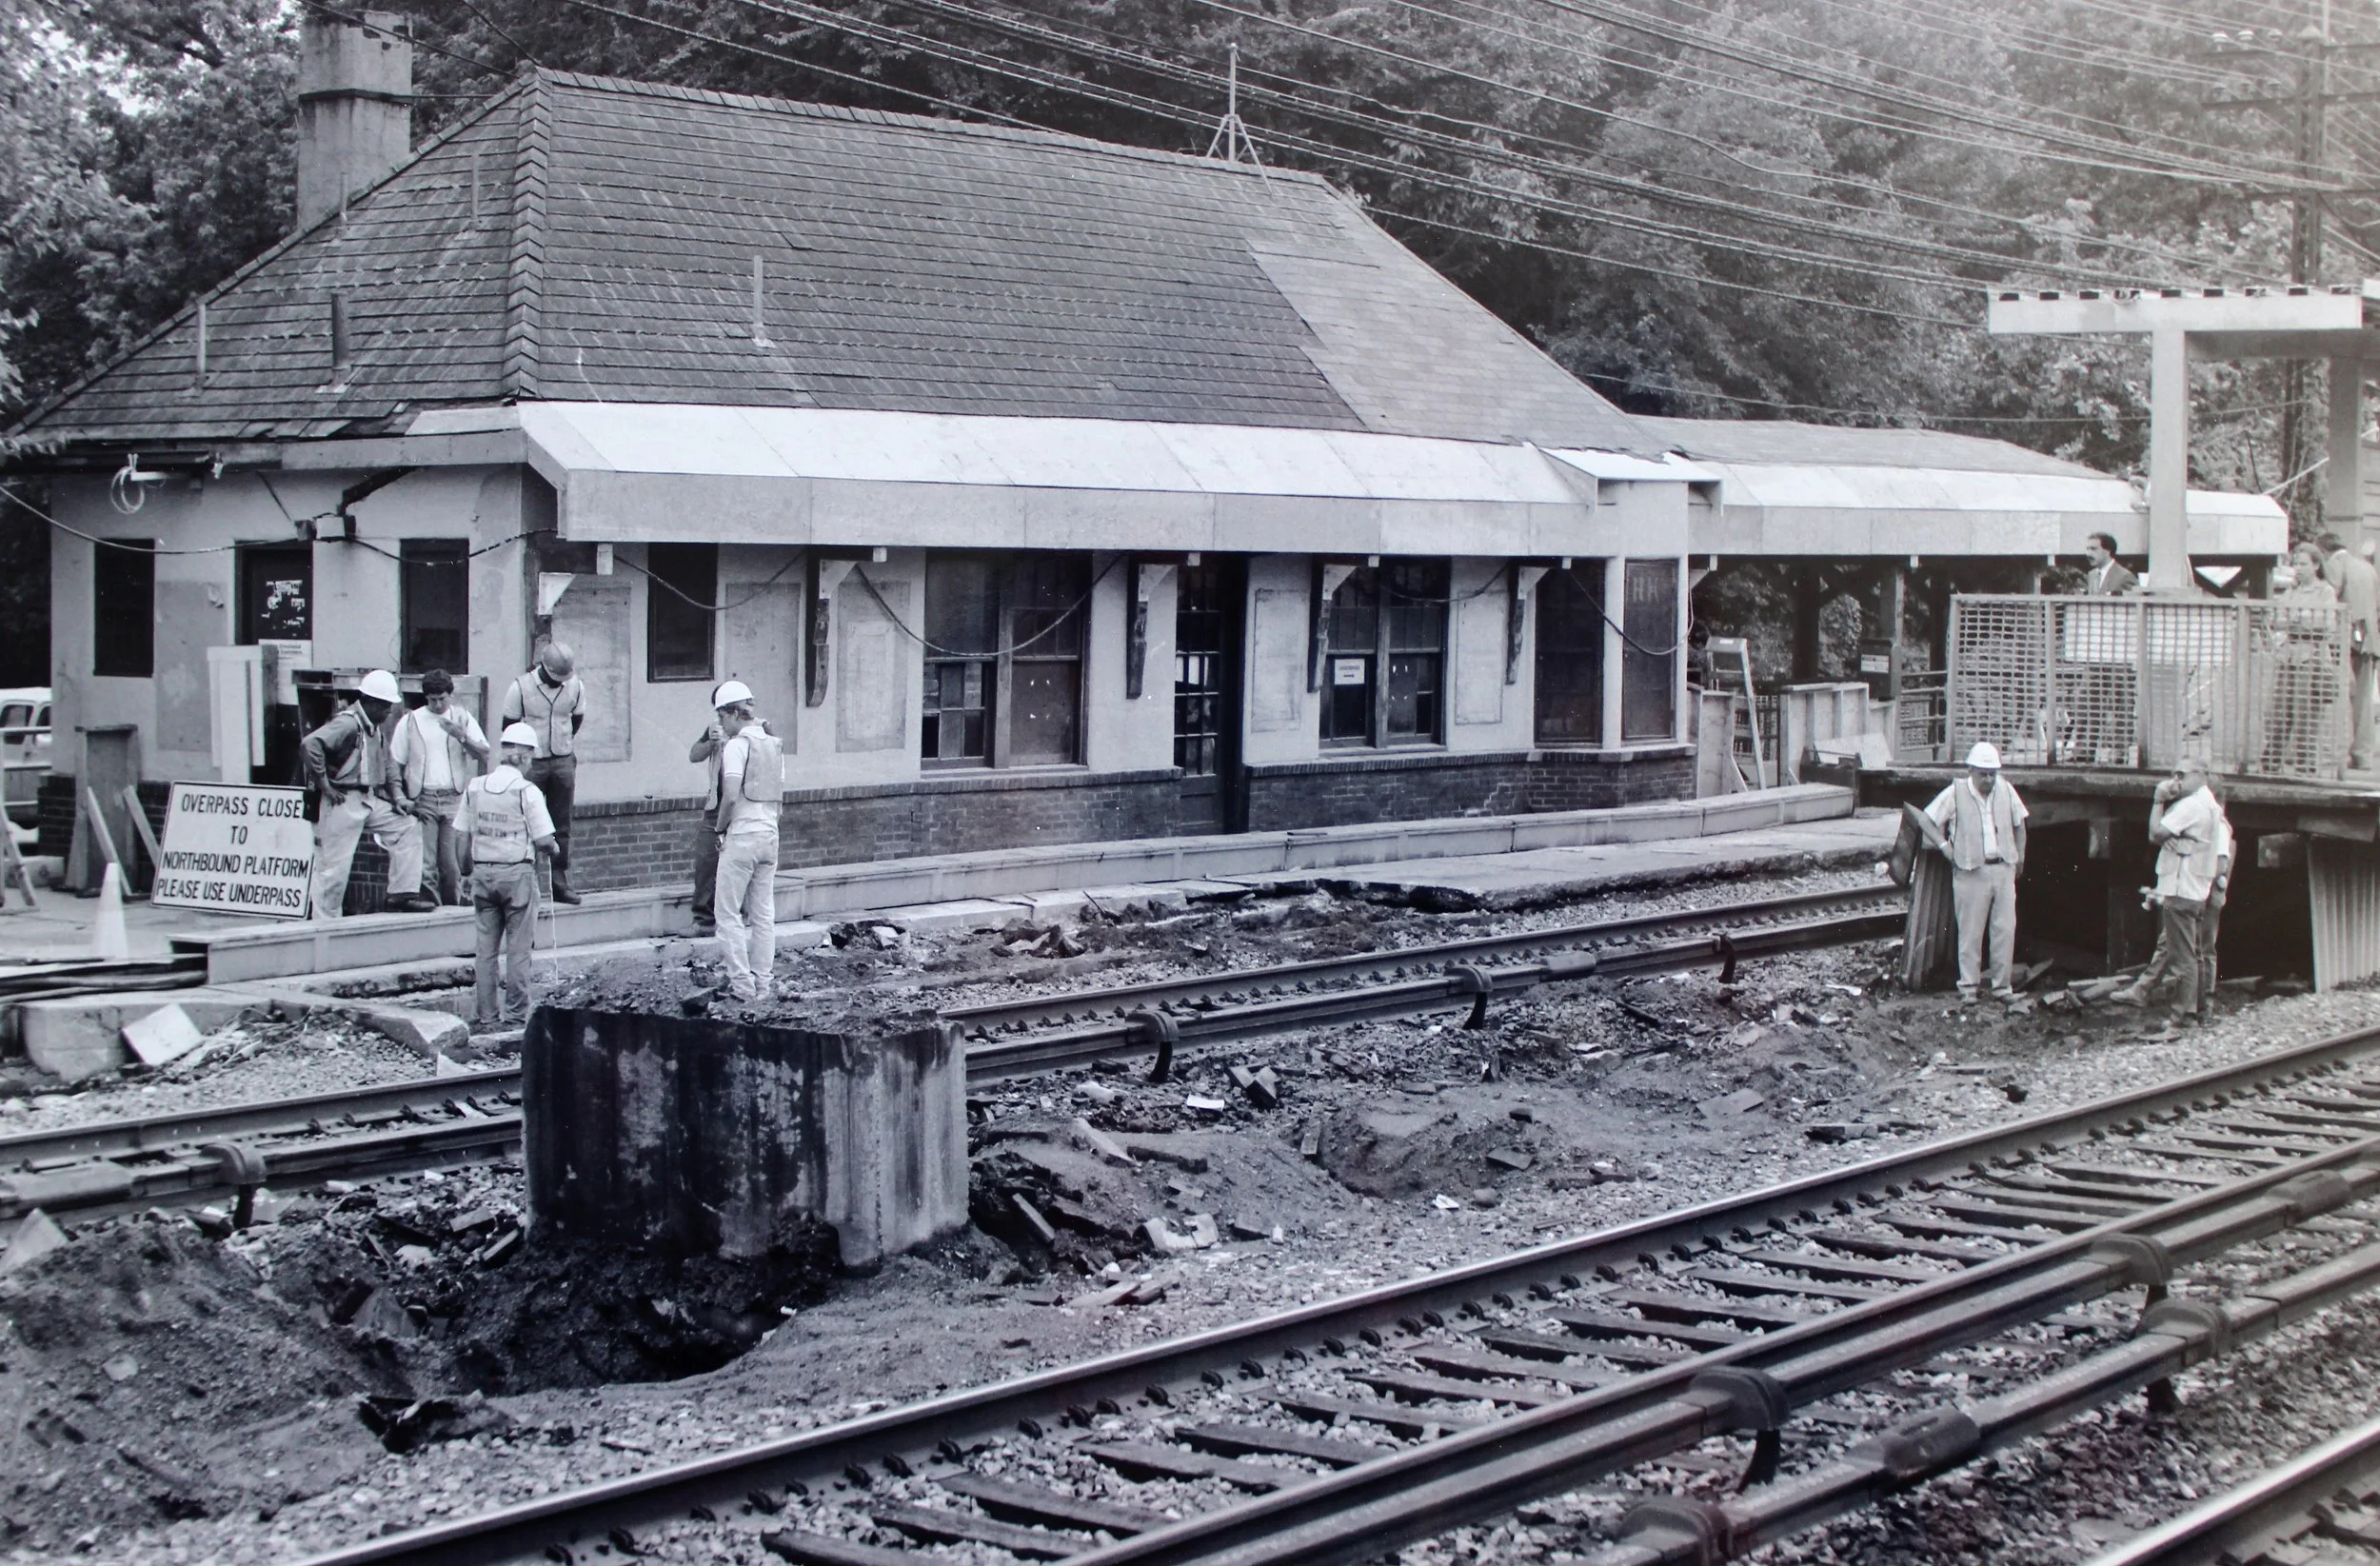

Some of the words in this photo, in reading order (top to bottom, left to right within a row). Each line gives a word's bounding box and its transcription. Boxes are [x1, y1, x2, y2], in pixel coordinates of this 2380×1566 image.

[182, 793, 249, 816] OVERPASS
[478, 811, 508, 823] METRO
[230, 825, 248, 844] TO
[162, 851, 241, 874] NORTHBOUND
[244, 855, 309, 879] PLATFORM
[155, 878, 201, 899] PLEASE
[203, 882, 227, 902] USE
[228, 883, 302, 907] UNDERPASS
